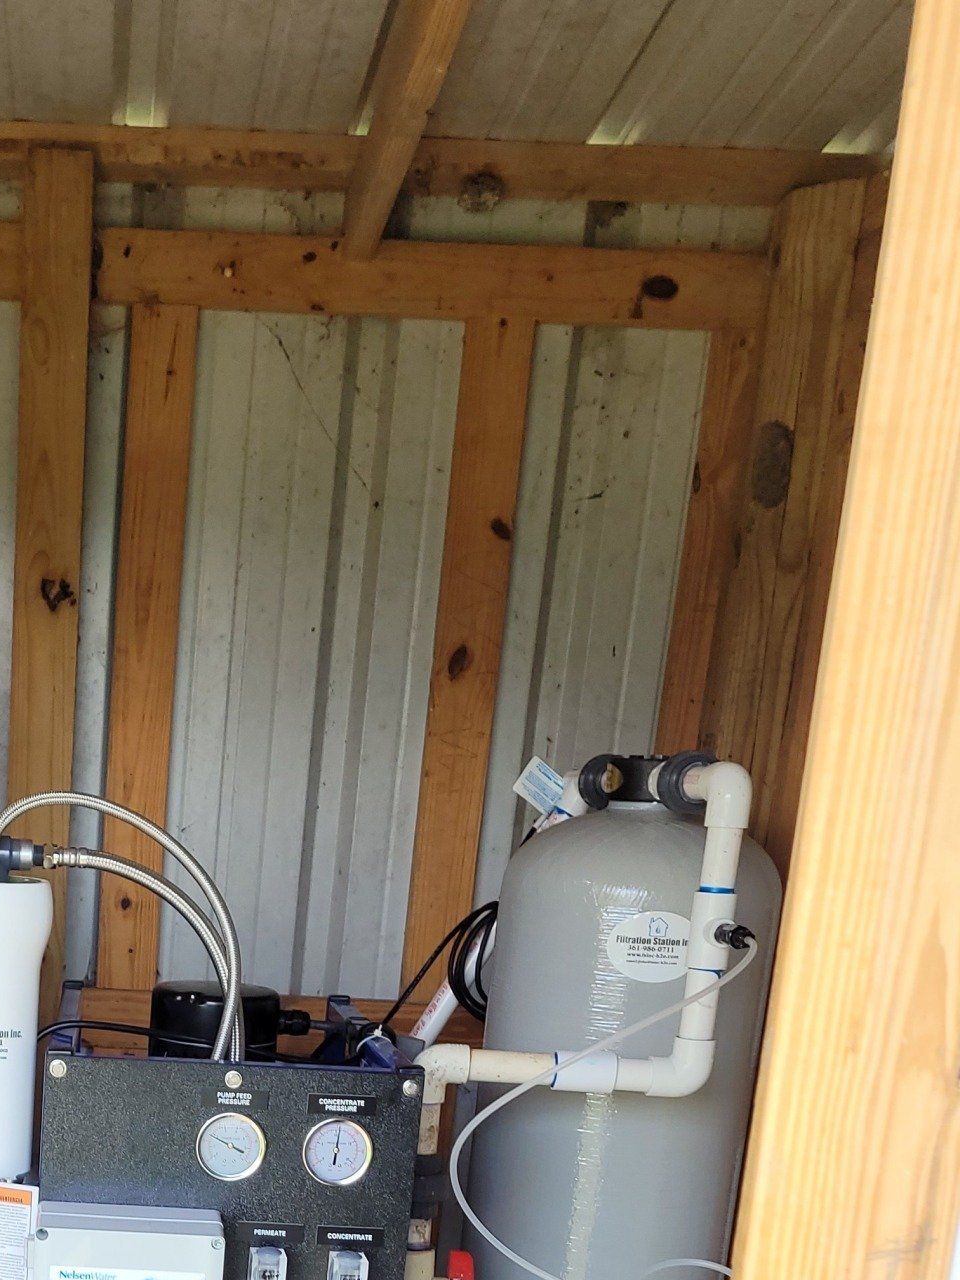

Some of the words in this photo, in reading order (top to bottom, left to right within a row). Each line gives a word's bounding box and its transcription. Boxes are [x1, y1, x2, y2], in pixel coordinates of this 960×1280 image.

[616, 934, 651, 945] Filtration
[652, 937, 680, 946] Station
[10, 1029, 22, 1038] Inc.
[217, 1091, 235, 1099] PUMP
[236, 1092, 252, 1100] FEED
[218, 1097, 251, 1106] PRESSURE
[319, 1098, 365, 1106] CONCENTRATE
[254, 1228, 286, 1237] PERMEATE
[327, 1232, 373, 1242] CONCENTRATE
